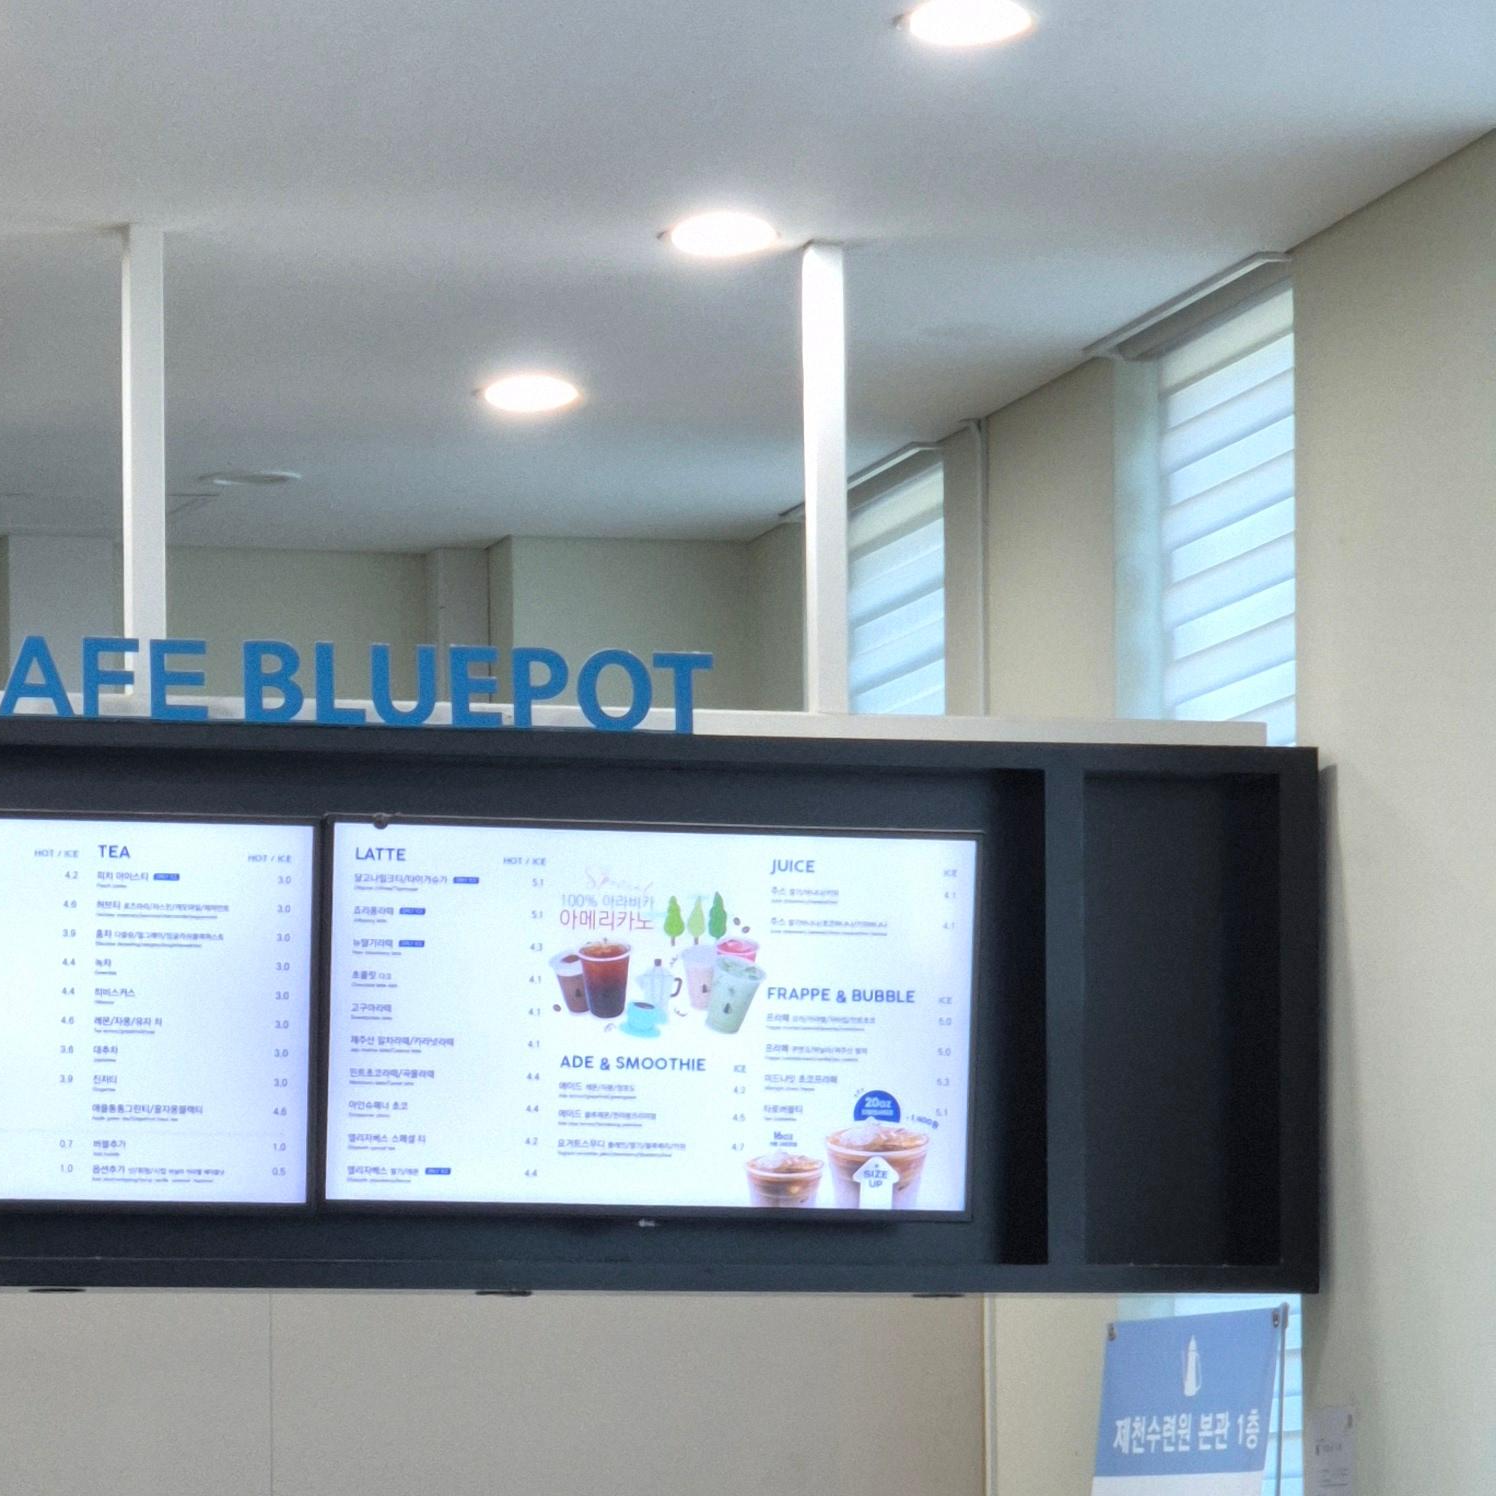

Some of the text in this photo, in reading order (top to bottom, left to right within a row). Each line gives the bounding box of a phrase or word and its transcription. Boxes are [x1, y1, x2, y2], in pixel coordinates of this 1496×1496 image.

[243, 640, 713, 735] BLUEPOT
[97, 844, 131, 859] TEA
[355, 847, 407, 862] LATTE
[503, 857, 522, 865] HOT
[770, 859, 816, 875] JUICE
[65, 870, 79, 880] 4.2
[277, 875, 292, 885] 3.0
[532, 878, 544, 888] 5.1
[561, 894, 654, 910] 100% 아라비카
[277, 904, 292, 914] 3.0
[531, 910, 544, 919] 5.1
[559, 909, 654, 931] 아메리카노
[276, 933, 291, 943] 3.0
[62, 957, 76, 967] 4.4
[275, 962, 291, 971] 3.0
[529, 975, 542, 984] 4.1
[61, 986, 75, 996] 4.4
[275, 991, 290, 1000] 3.0
[767, 987, 916, 1004] FRAPPE & BUBBLE
[528, 1007, 541, 1016] 4.1
[274, 1020, 289, 1030] 3.0
[527, 1040, 540, 1049] 4.1
[274, 1048, 289, 1058] 3.0
[560, 1055, 706, 1072] ADE & SMOOTHIE
[526, 1072, 540, 1081] 4.4
[273, 1078, 288, 1088] 3.0
[526, 1104, 539, 1113] 4.4
[59, 1139, 74, 1149] 0.7
[273, 1142, 287, 1152] 1.0
[60, 1163, 74, 1173] 1.0
[272, 1167, 287, 1176] 0.5
[524, 1169, 538, 1178] 4.4
[863, 1170, 888, 1179] SIZE
[868, 1180, 883, 1188] UP
[1112, 1408, 1261, 1456] 제천수련원 본관 1층
